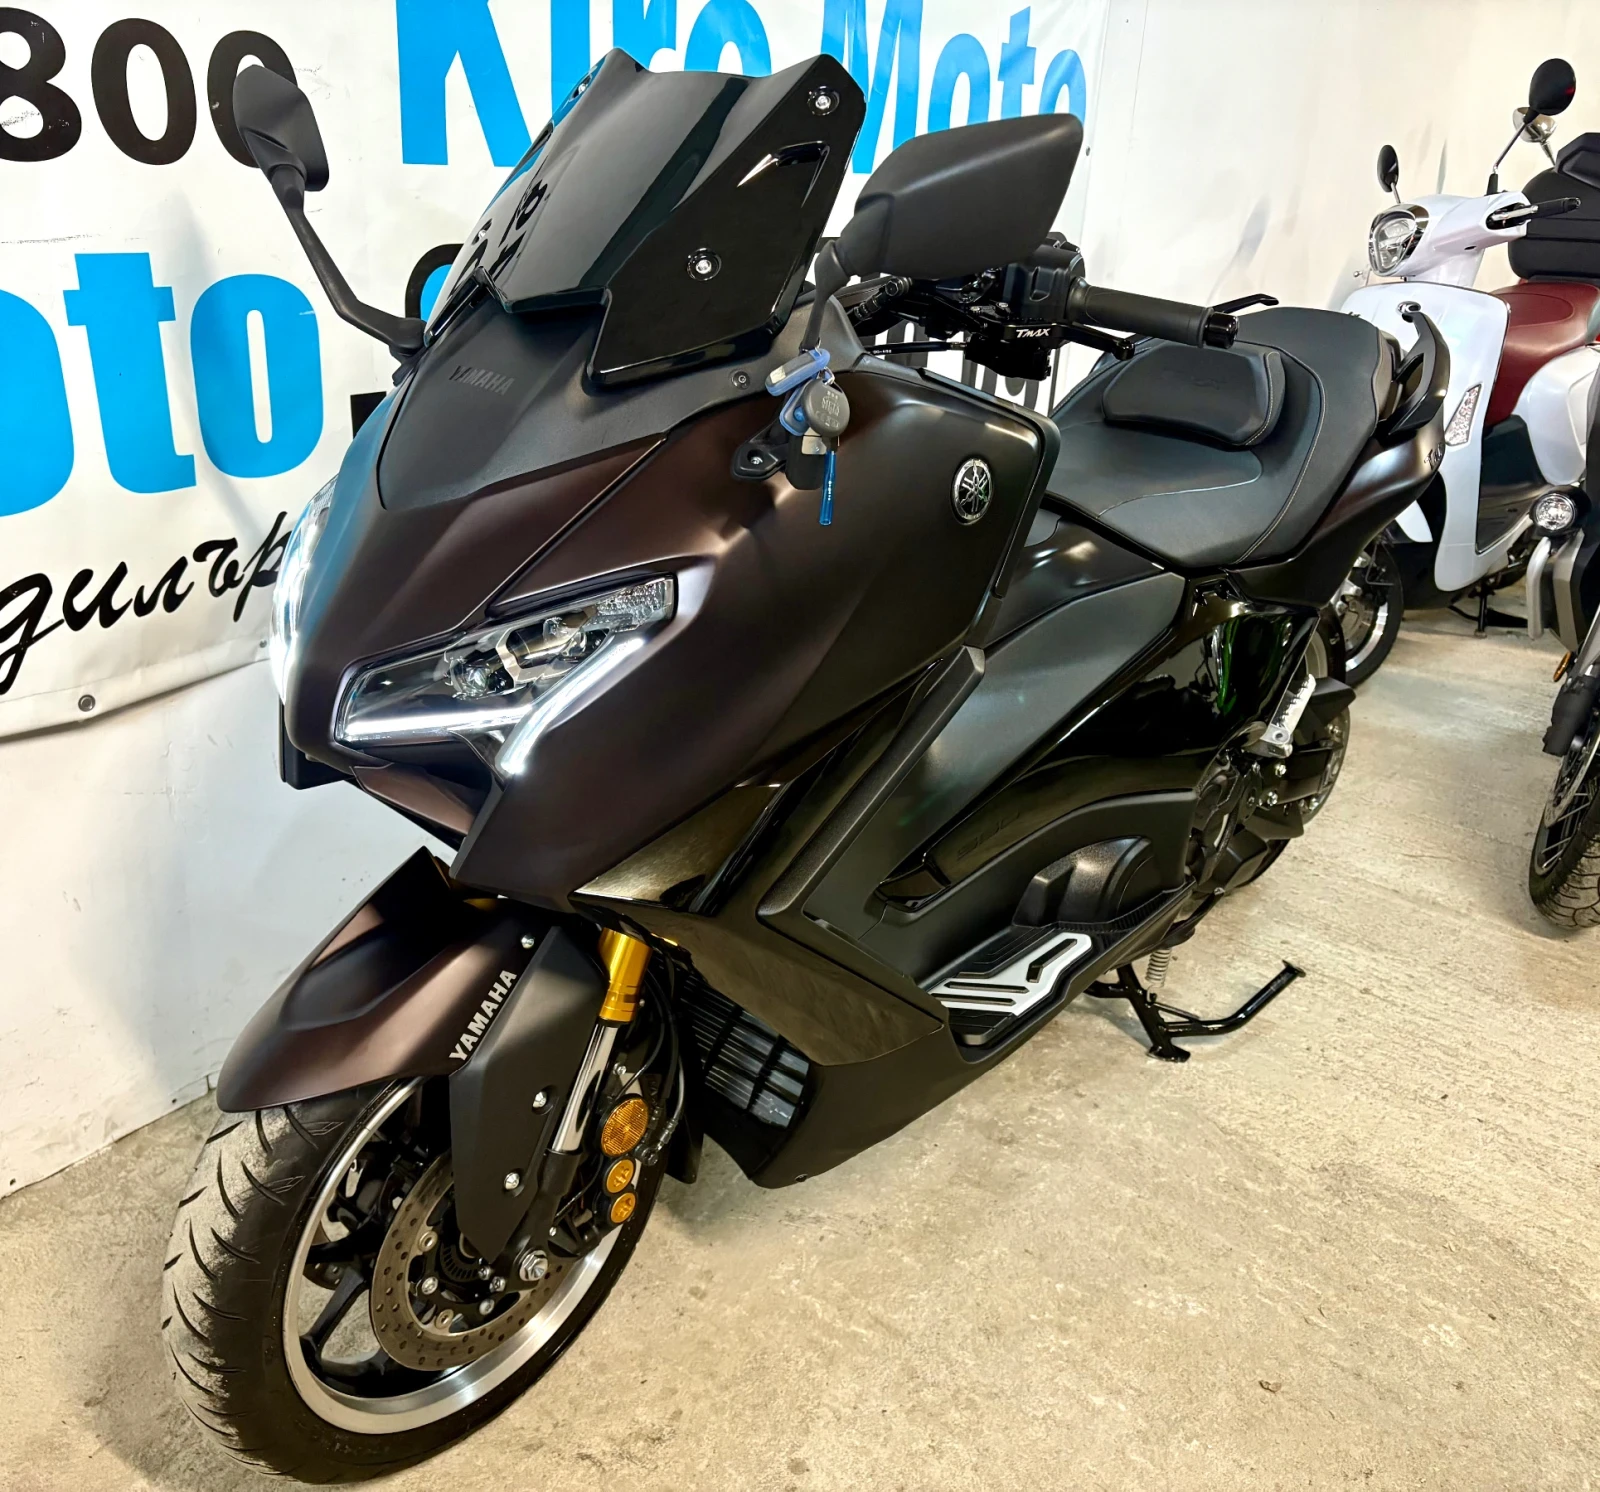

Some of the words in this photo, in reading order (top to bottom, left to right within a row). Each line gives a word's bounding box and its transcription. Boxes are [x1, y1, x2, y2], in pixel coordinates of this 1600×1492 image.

[0, 7, 297, 168] 800
[1016, 328, 1051, 338] TMAX
[449, 365, 515, 395] YAMAHA
[448, 969, 518, 1061] YAMAHA
